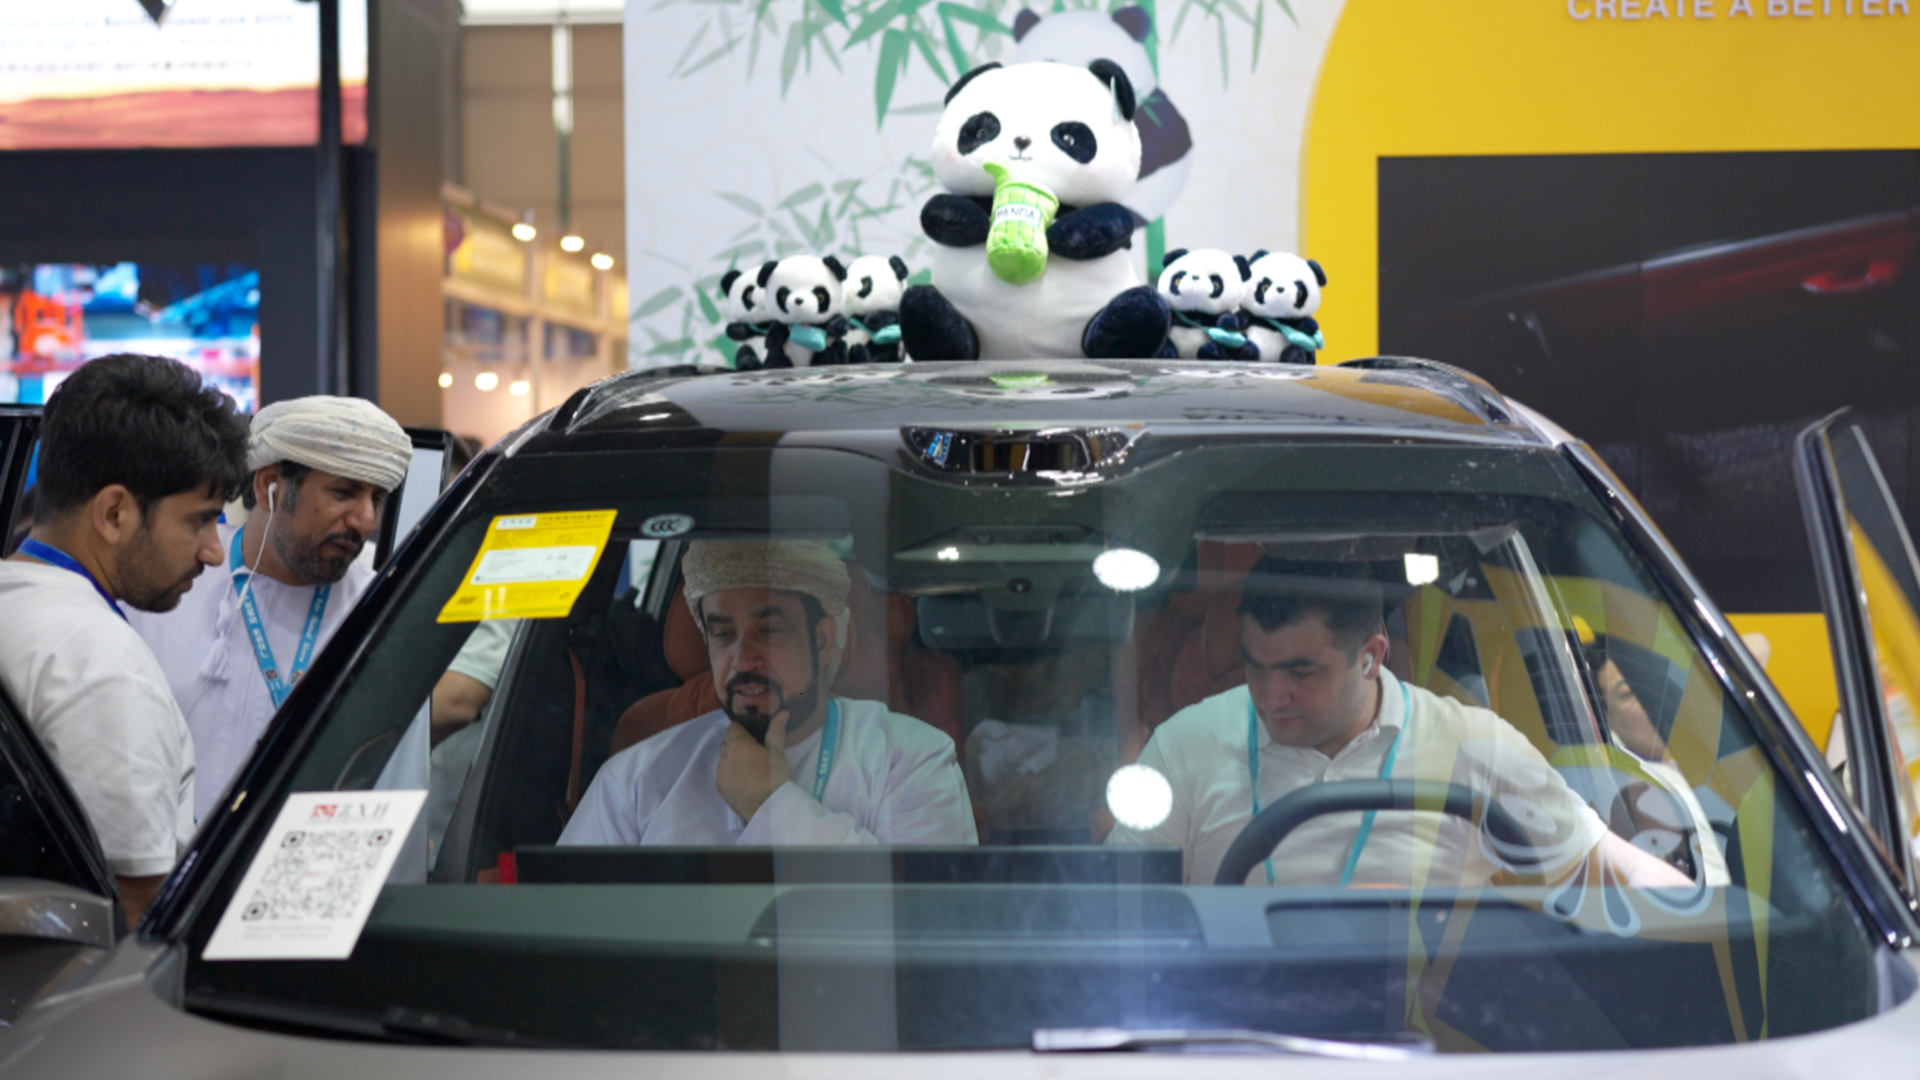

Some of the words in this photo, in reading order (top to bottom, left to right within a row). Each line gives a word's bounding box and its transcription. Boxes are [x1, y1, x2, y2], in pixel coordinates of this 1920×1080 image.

[1567, 0, 1716, 20] CREATE
[1728, 0, 1754, 18] A
[1766, 0, 1911, 17] BETTER
[996, 206, 1035, 220] PANDA
[298, 642, 311, 663] Share
